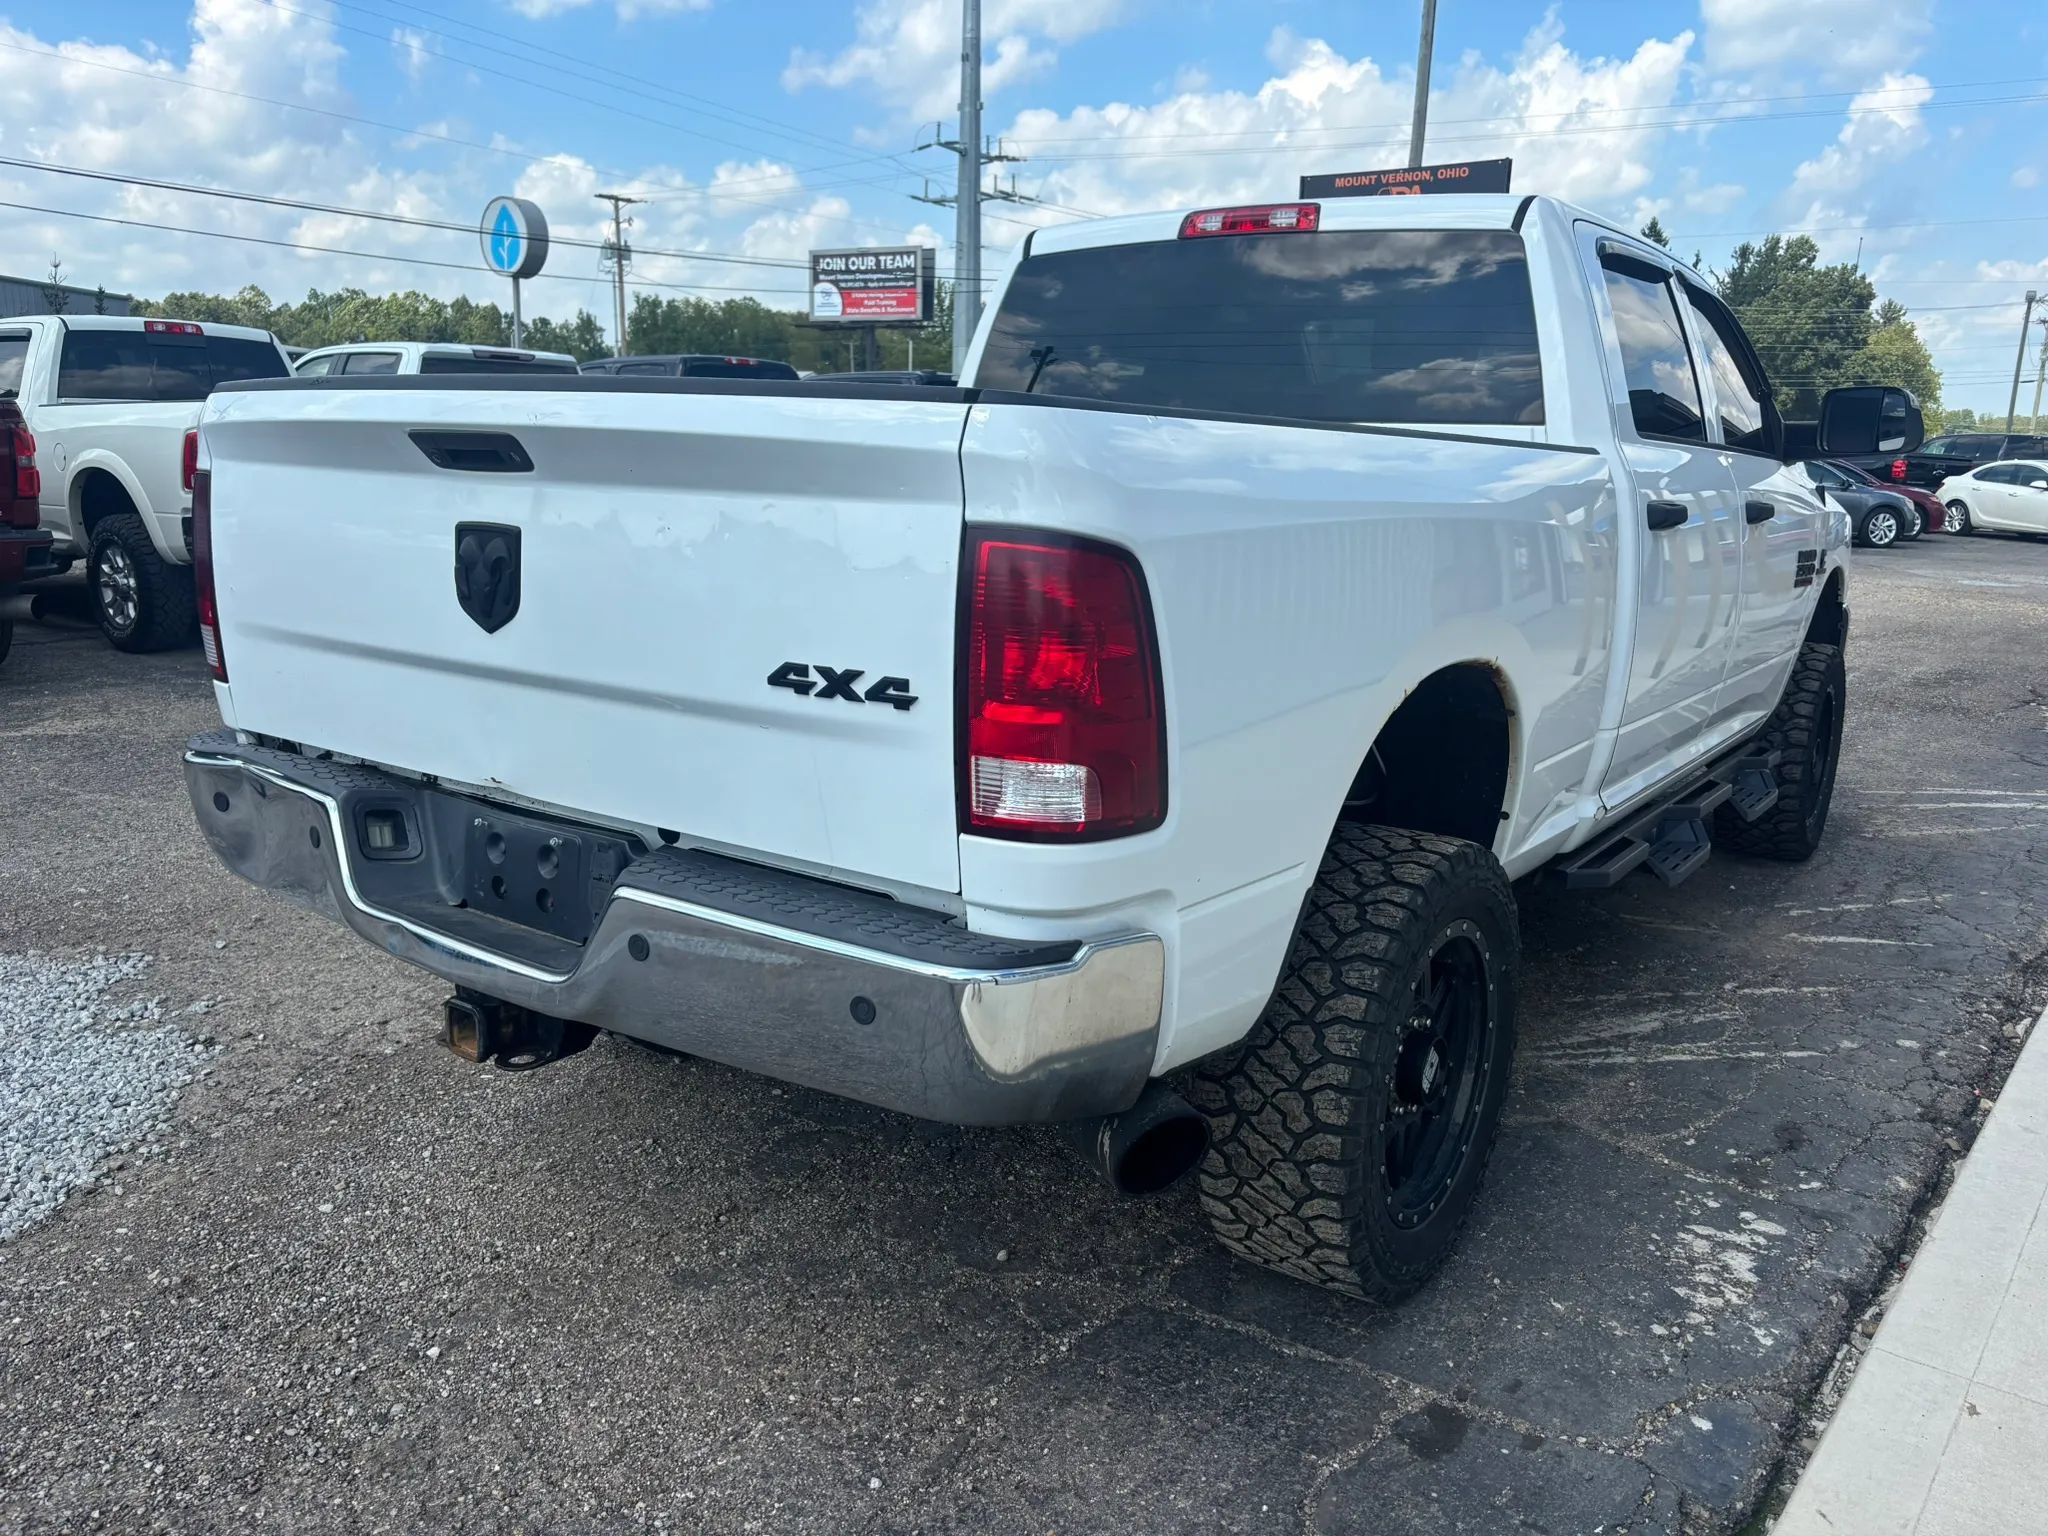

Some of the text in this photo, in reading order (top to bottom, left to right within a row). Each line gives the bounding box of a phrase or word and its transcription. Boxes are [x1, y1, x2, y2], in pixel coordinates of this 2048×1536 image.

[1335, 167, 1470, 188] MOUNT VERNON, OHIO
[817, 254, 915, 271] JOIN OUR TEAM
